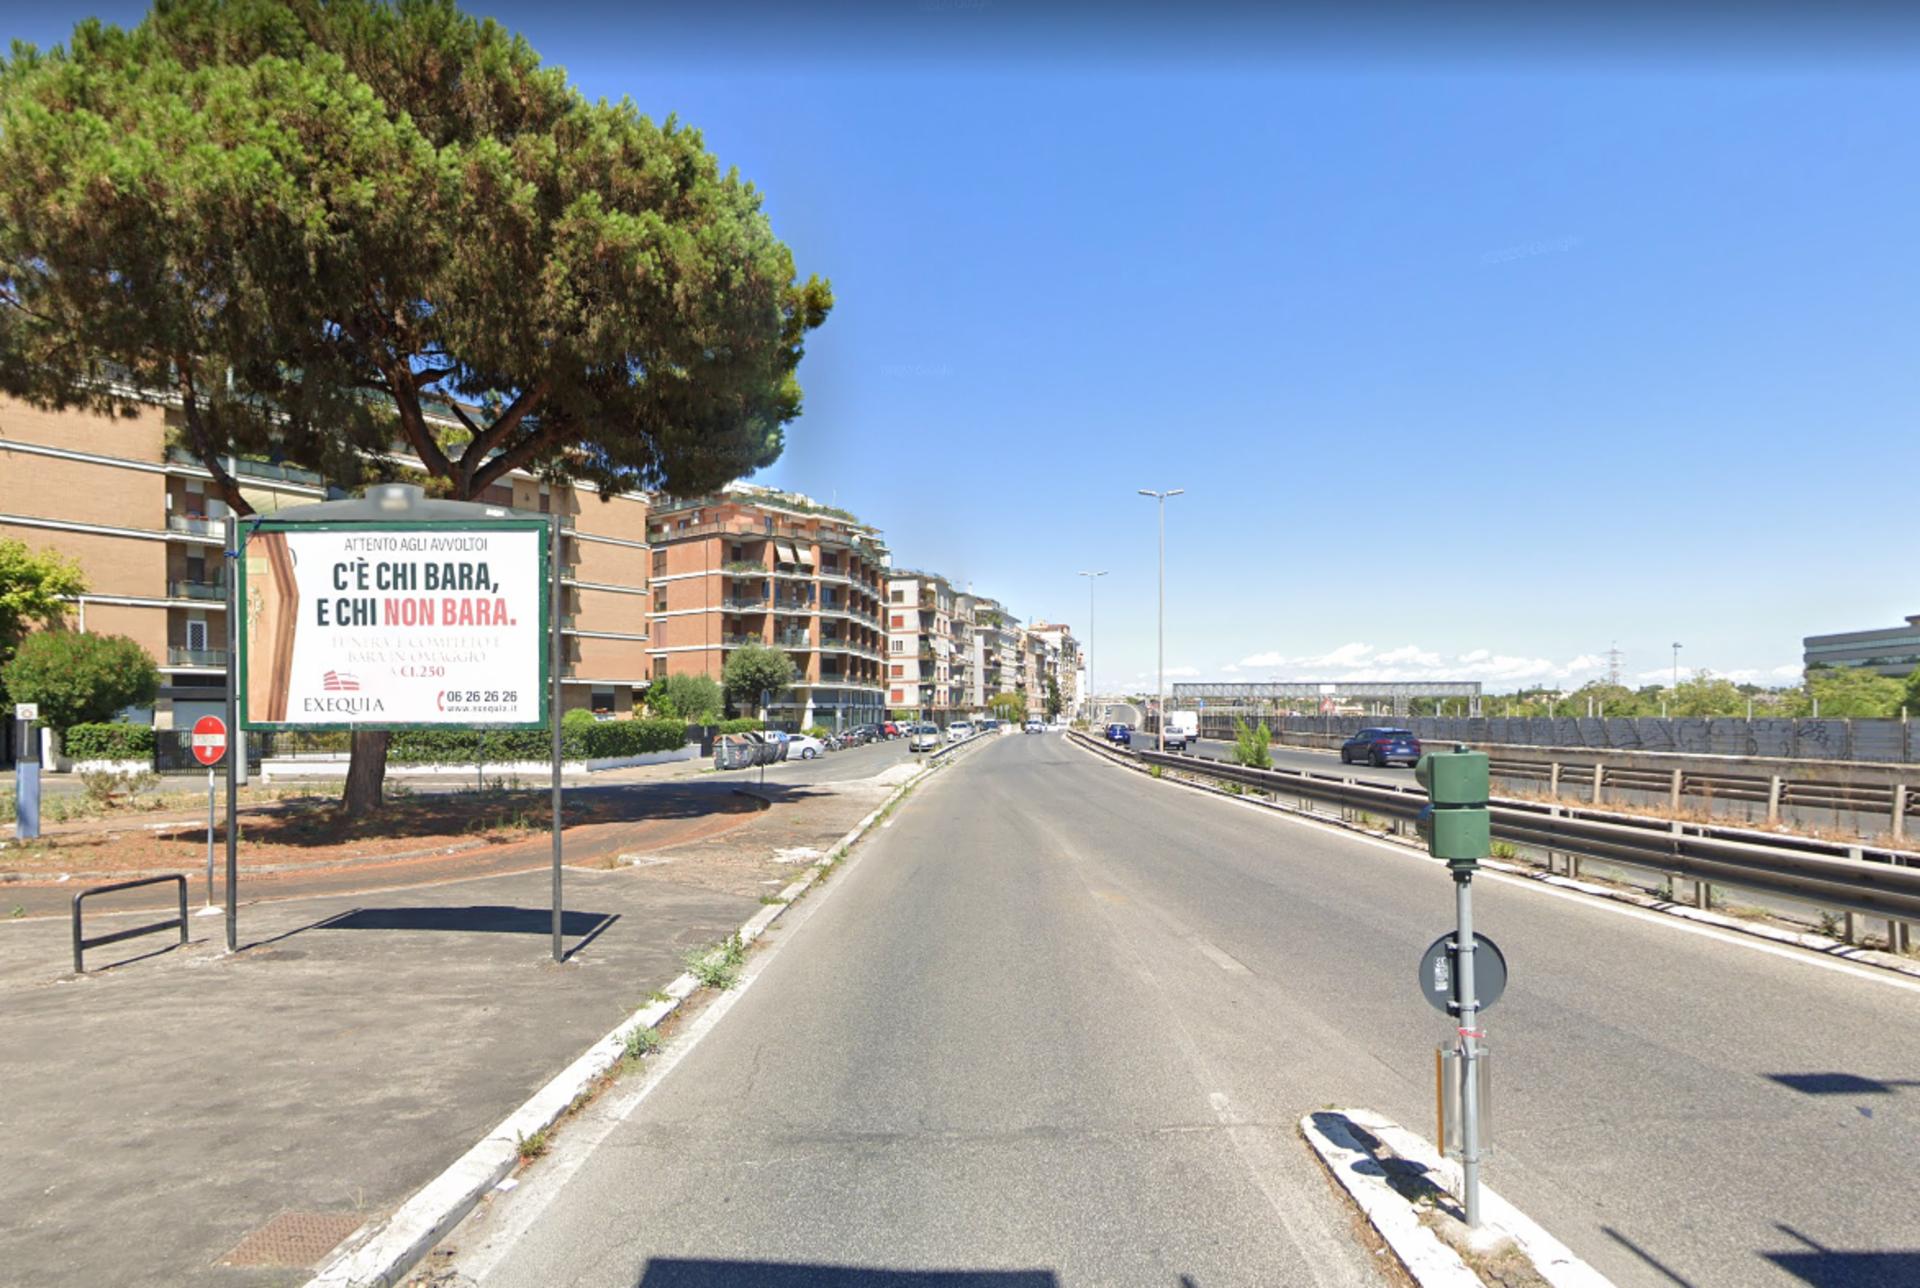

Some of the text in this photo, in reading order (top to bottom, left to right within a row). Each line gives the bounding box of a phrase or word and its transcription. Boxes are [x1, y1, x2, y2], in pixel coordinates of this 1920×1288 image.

[344, 537, 488, 551] ATTENTO AGLI AVVOLTOI
[333, 556, 499, 594] C'È CHI BARA,
[317, 597, 517, 627] E CHI NON BARA.
[447, 691, 518, 702] 06 26 26 26
[304, 697, 385, 715] EXEQUIA
